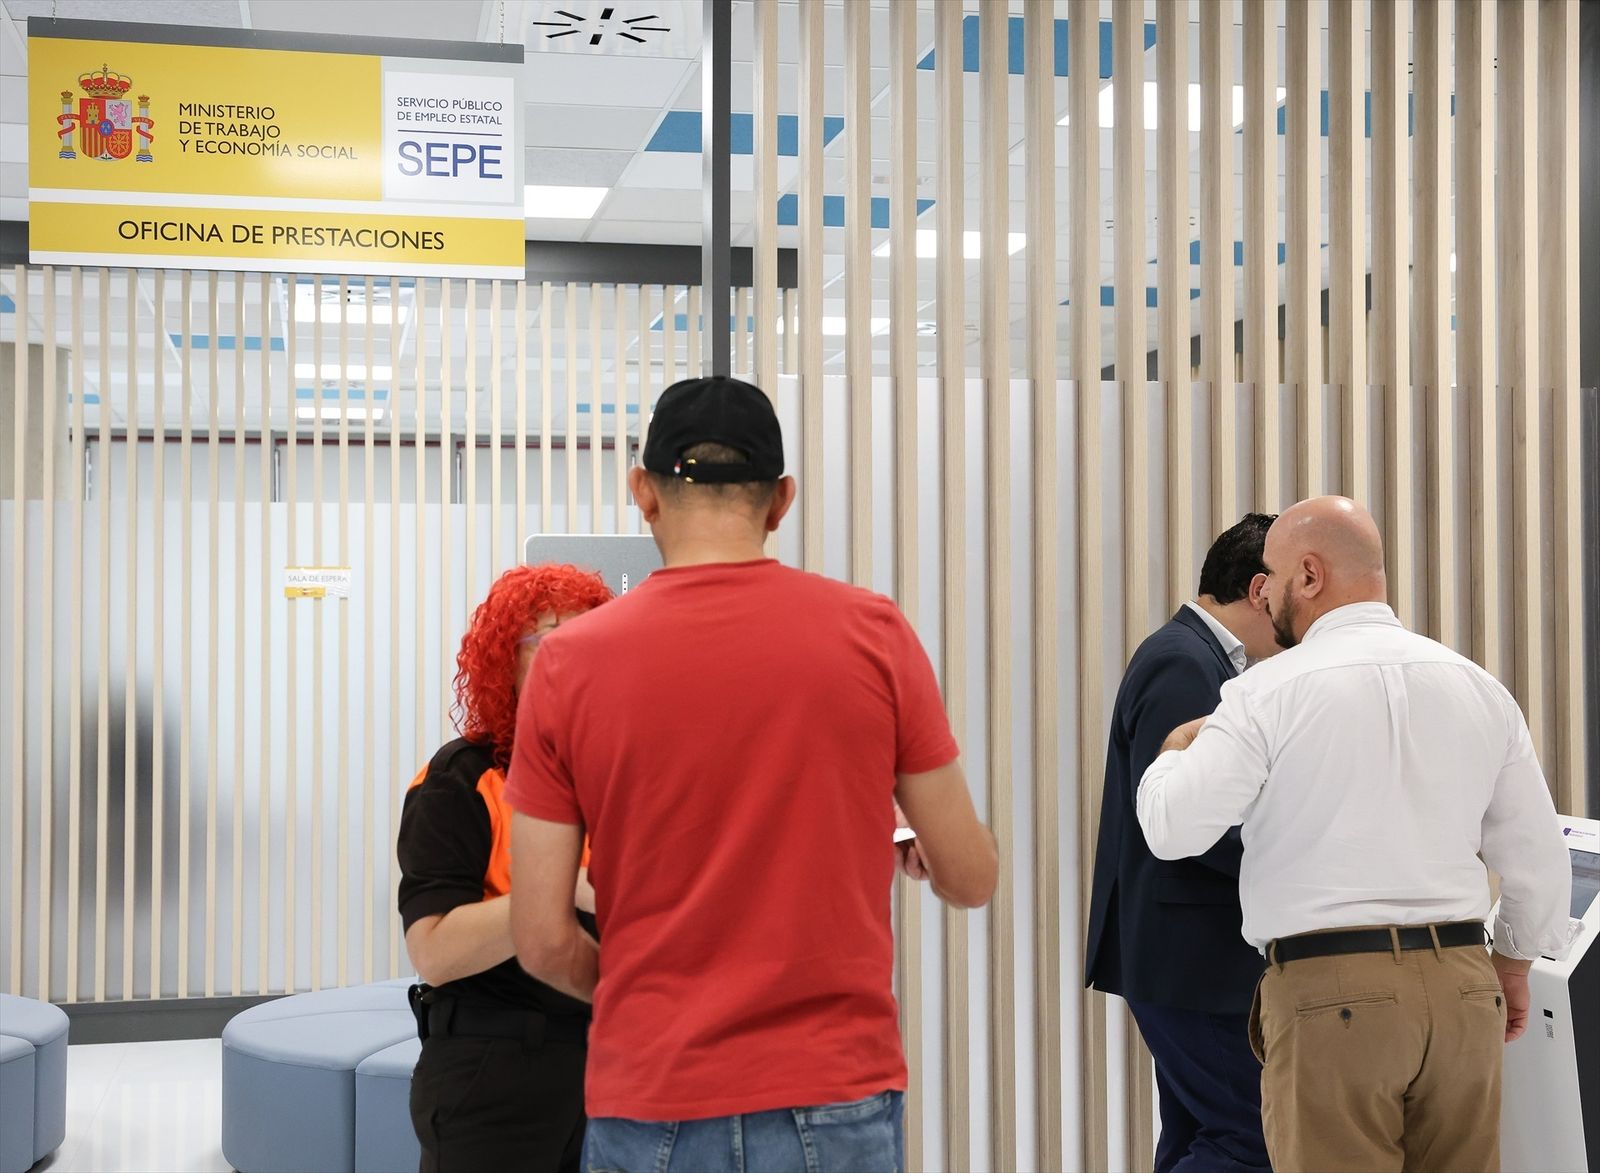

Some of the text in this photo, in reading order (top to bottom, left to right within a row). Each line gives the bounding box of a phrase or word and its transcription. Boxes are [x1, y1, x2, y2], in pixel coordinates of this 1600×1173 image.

[179, 103, 275, 120] MINISTERIO
[397, 97, 503, 111] SERVICIO PÚBLICO
[397, 111, 503, 125] DE EMPLEO ESTATAL
[179, 121, 281, 141] DE TRABAJO
[179, 139, 358, 160] Y ECONOMÍA SOCIAL
[398, 140, 503, 179] SEPE
[118, 220, 445, 251] OFICINA DE PRESTACIONES
[288, 575, 307, 583] SALA
[308, 575, 319, 583] DE
